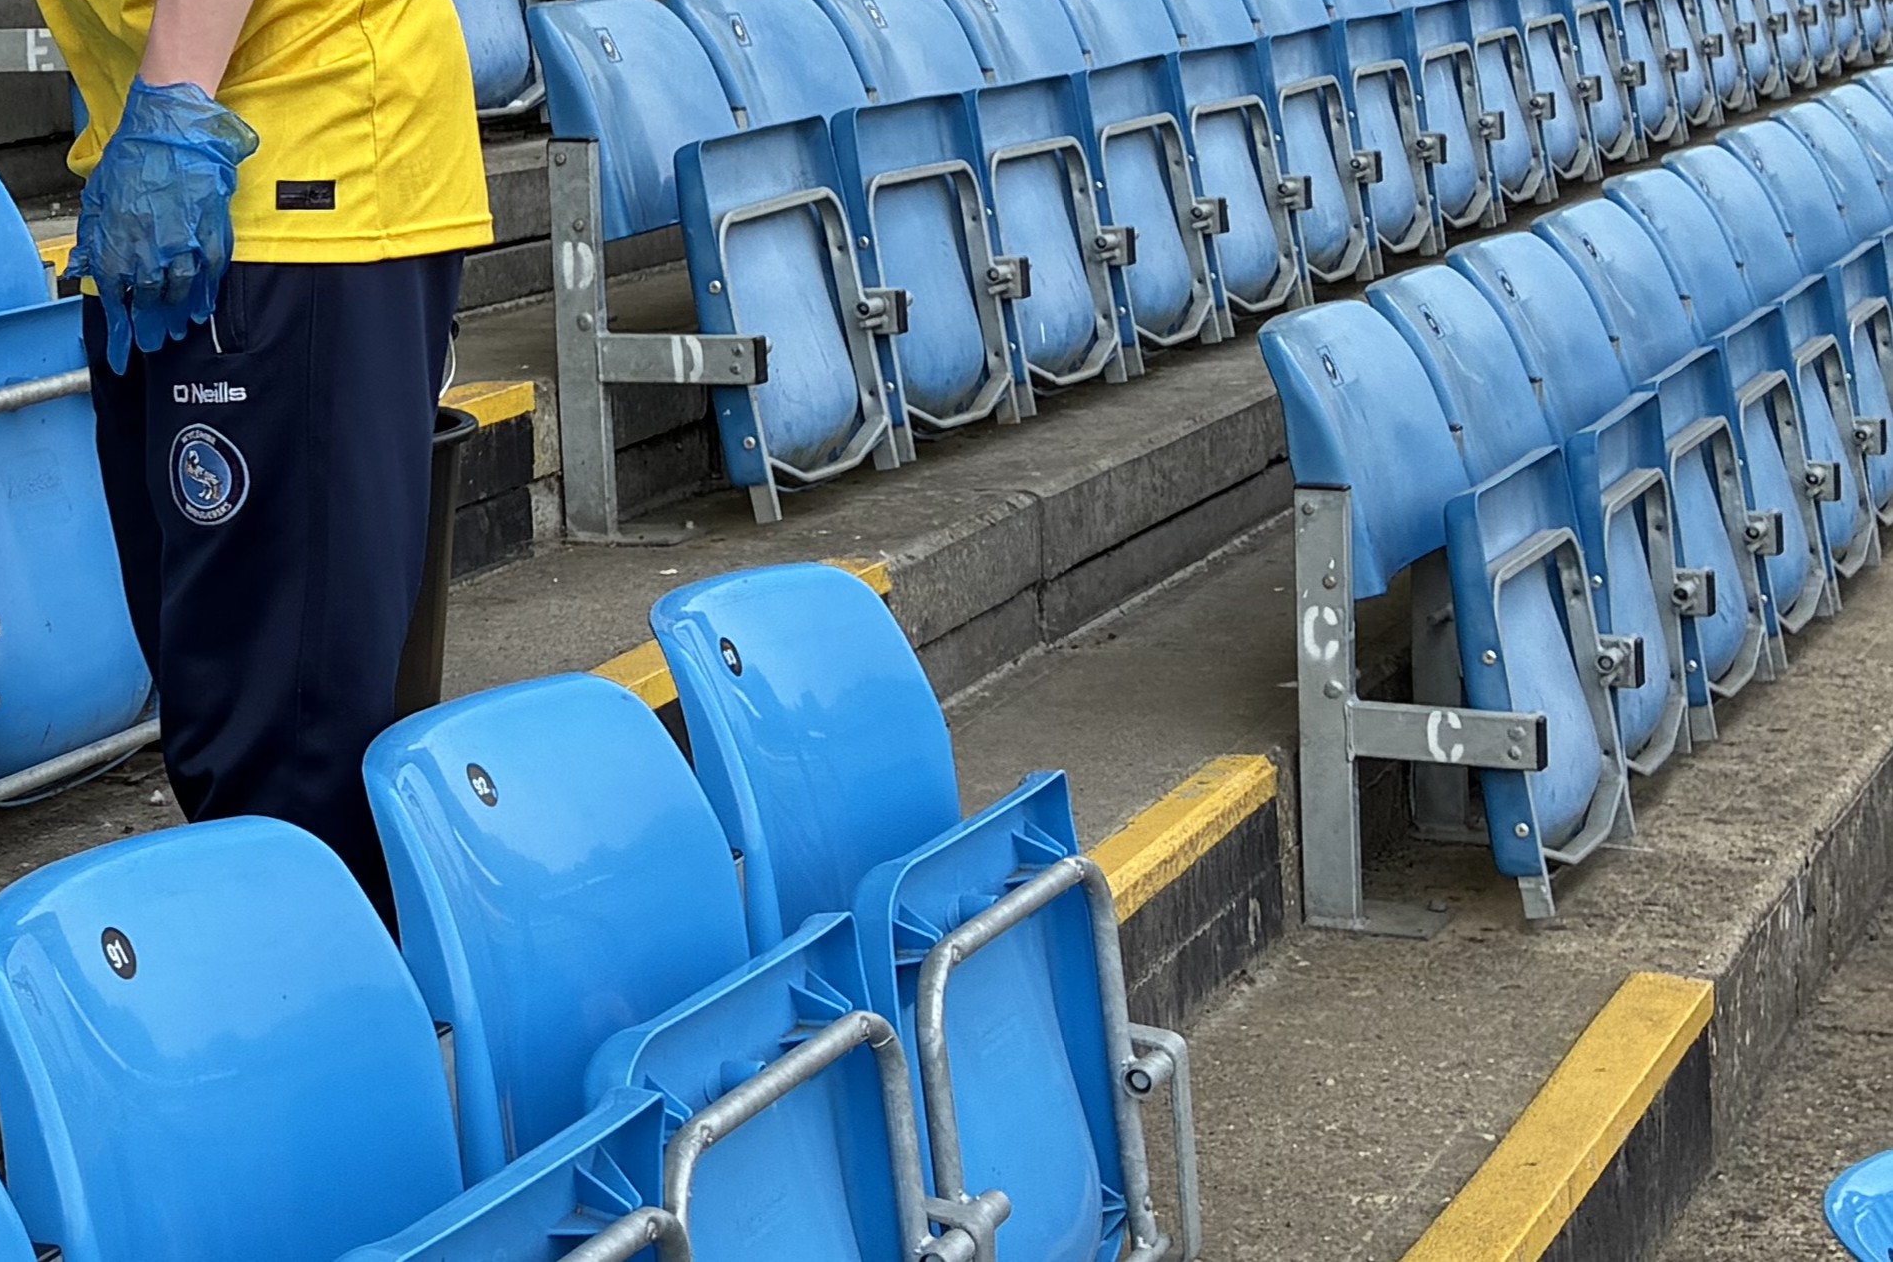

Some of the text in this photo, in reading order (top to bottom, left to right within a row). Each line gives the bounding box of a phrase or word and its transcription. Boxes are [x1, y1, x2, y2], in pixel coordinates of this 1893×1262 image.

[26, 28, 55, 72] E
[563, 241, 594, 289] D
[671, 335, 704, 383] D
[1303, 605, 1339, 661] C
[1427, 710, 1464, 762] C
[473, 776, 491, 796] 92
[107, 940, 129, 969] 91
